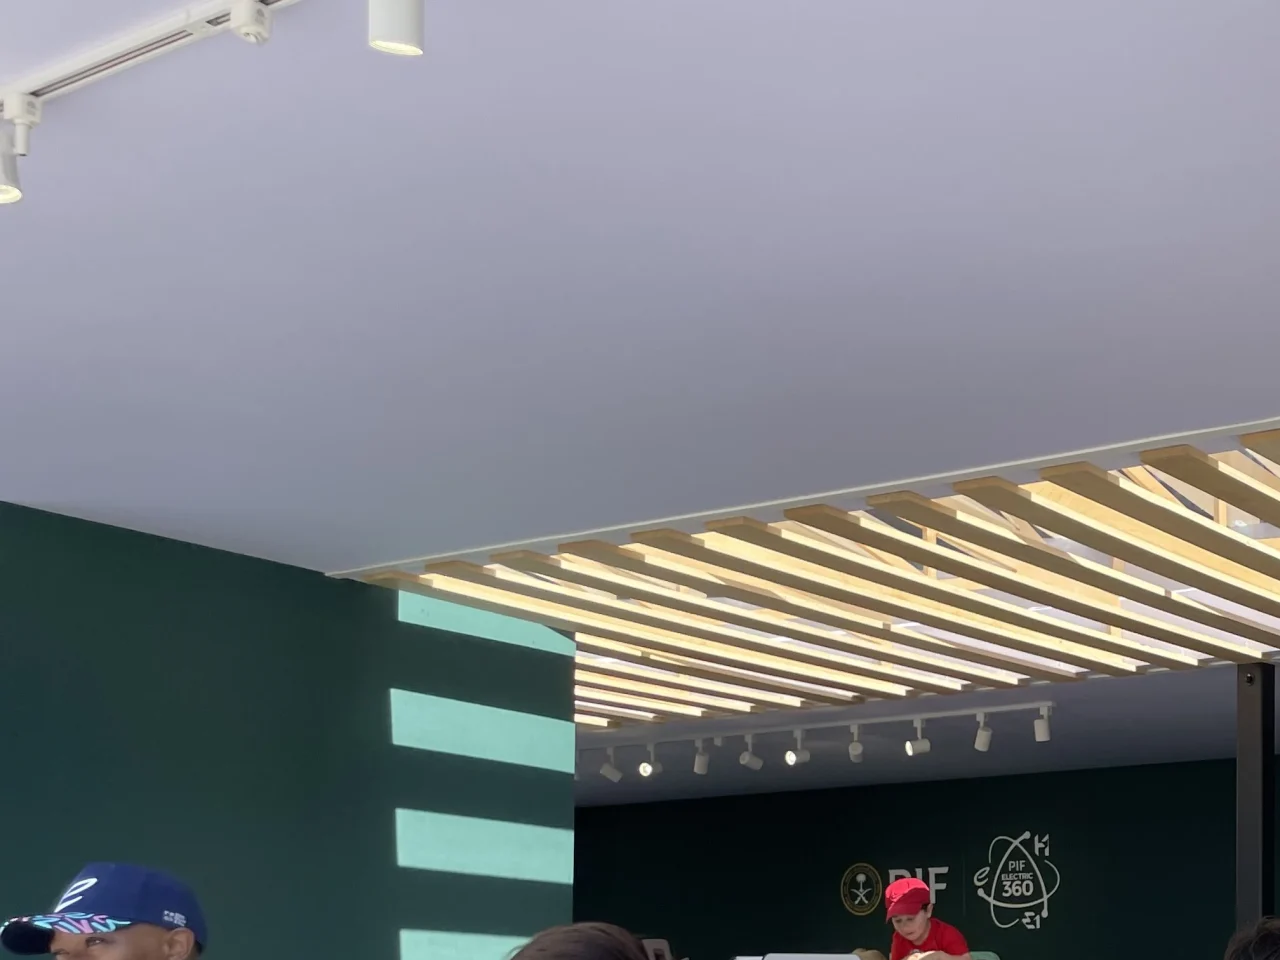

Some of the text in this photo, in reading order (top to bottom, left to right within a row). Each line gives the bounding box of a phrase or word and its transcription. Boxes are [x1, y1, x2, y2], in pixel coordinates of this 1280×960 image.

[1008, 860, 1026, 872] PIF
[1001, 872, 1034, 881] ELECTRIC
[1002, 880, 1034, 897] 360
